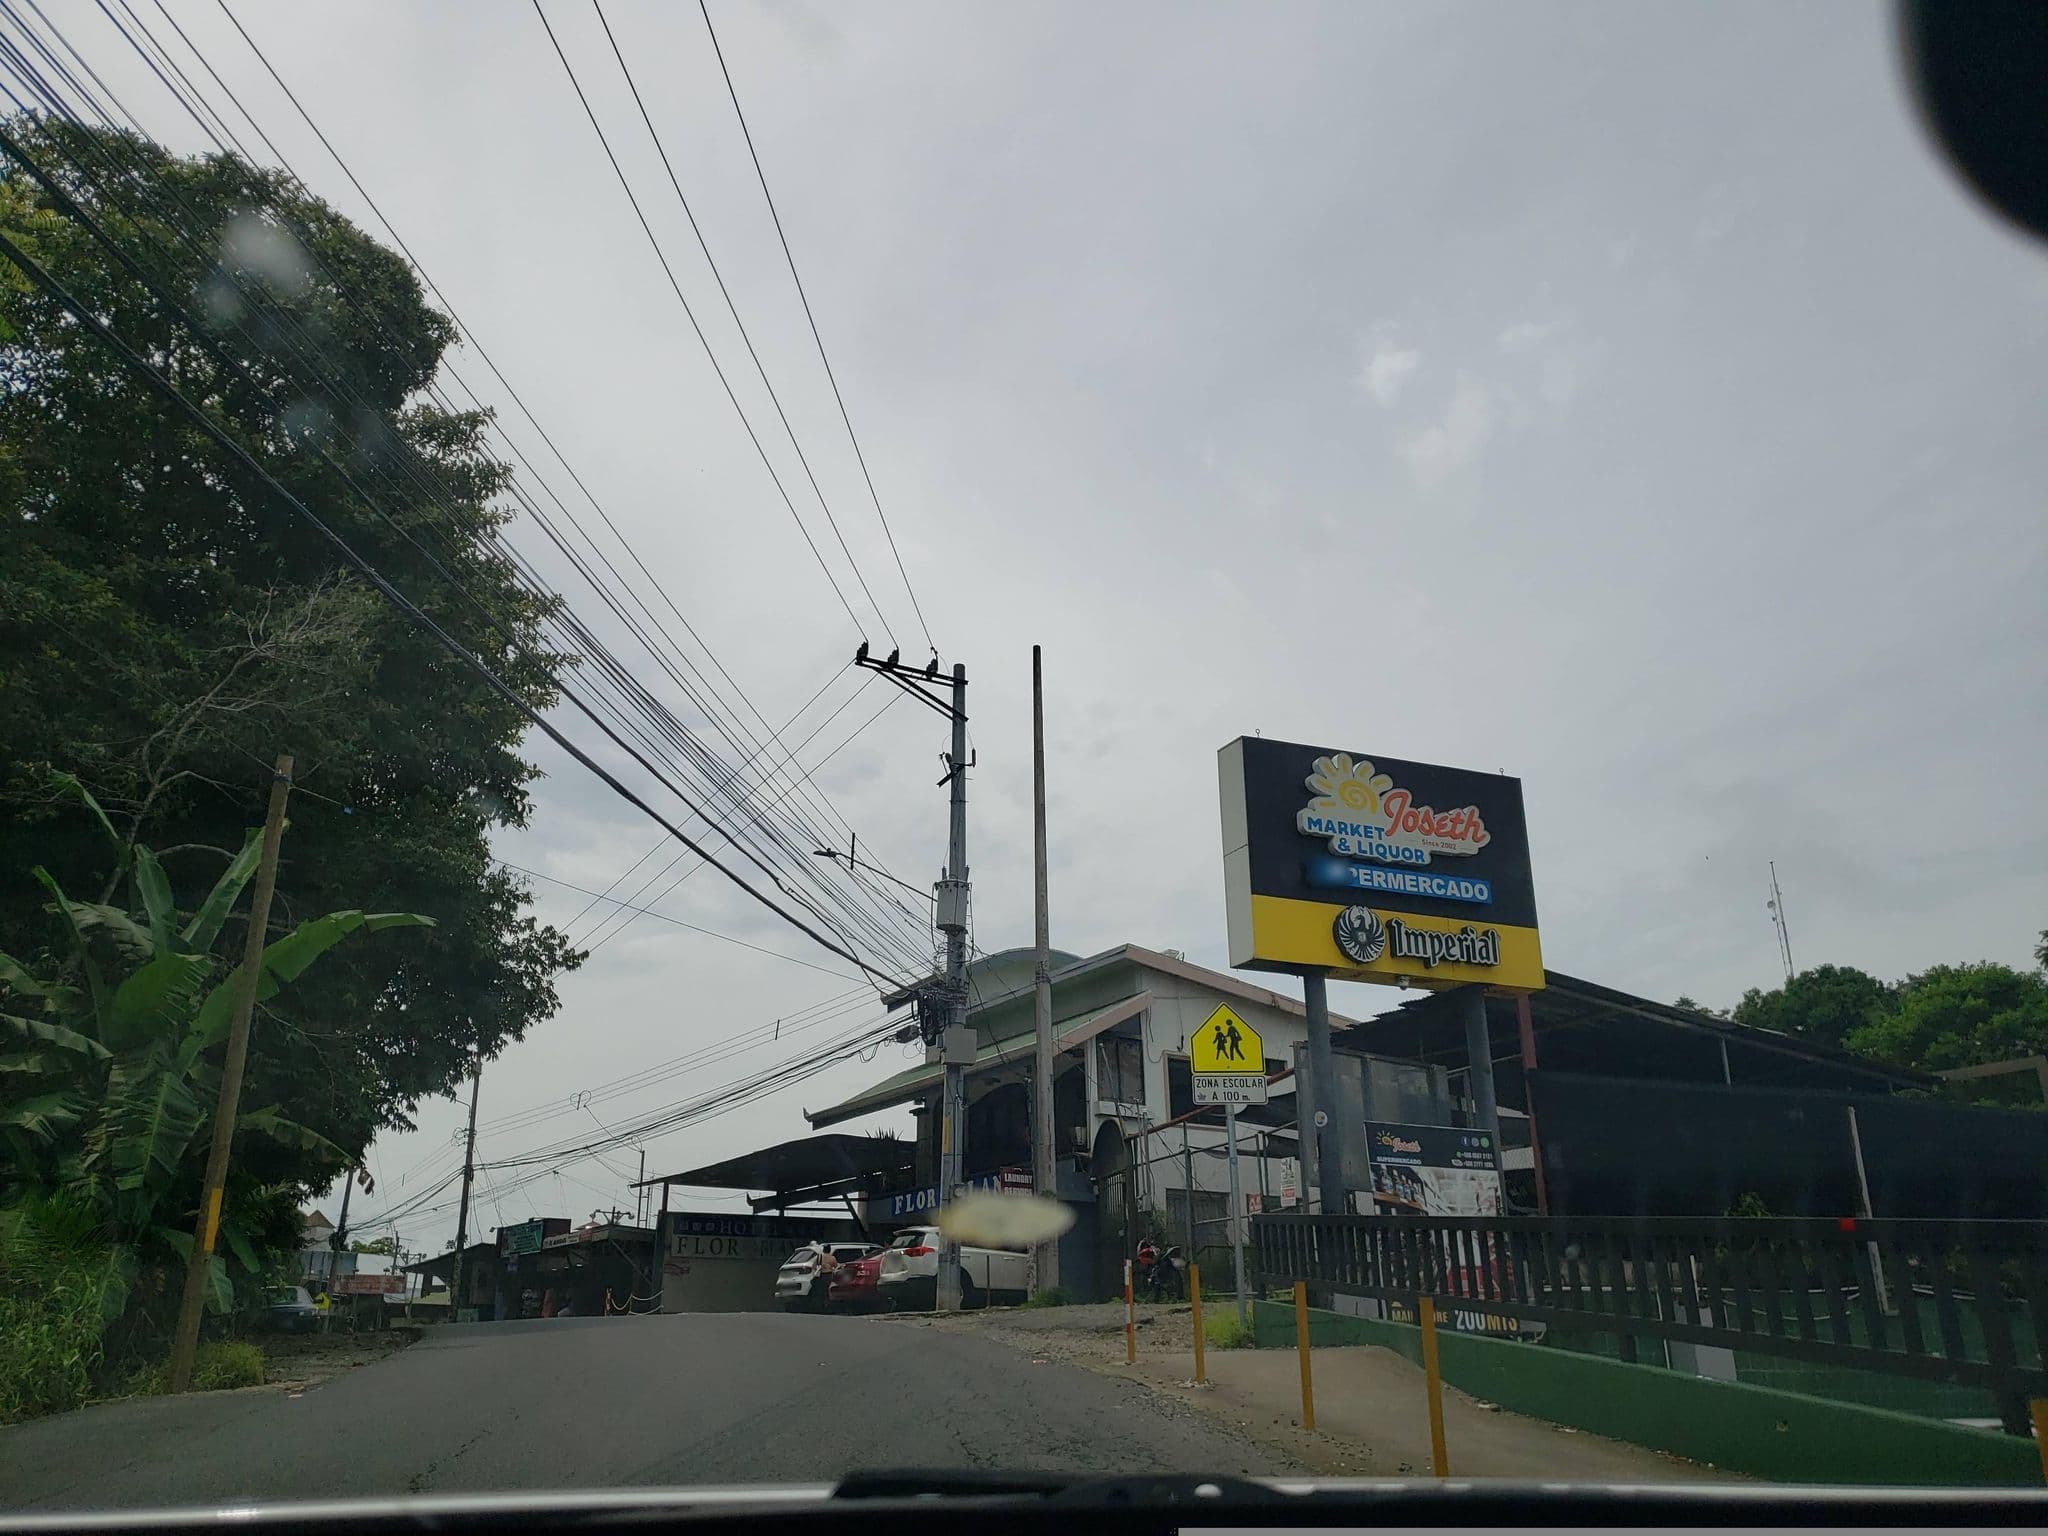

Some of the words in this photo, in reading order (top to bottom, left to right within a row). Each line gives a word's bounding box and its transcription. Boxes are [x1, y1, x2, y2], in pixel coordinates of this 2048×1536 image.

[1384, 791, 1486, 843] Joseth
[1307, 817, 1385, 840] MARKET
[1337, 837, 1351, 851] &
[1357, 839, 1426, 863] LIQUOR
[1440, 840, 1457, 850] 2002
[1387, 917, 1501, 968] Imperial
[1196, 1078, 1219, 1088] ZONA
[1222, 1078, 1264, 1089] ESCOLAR
[1212, 1091, 1219, 1101] A
[1223, 1091, 1240, 1101] 100
[1004, 1172, 1033, 1184] LAUNDRY
[894, 1187, 937, 1215] FLOR
[676, 1236, 739, 1256] FLOR
